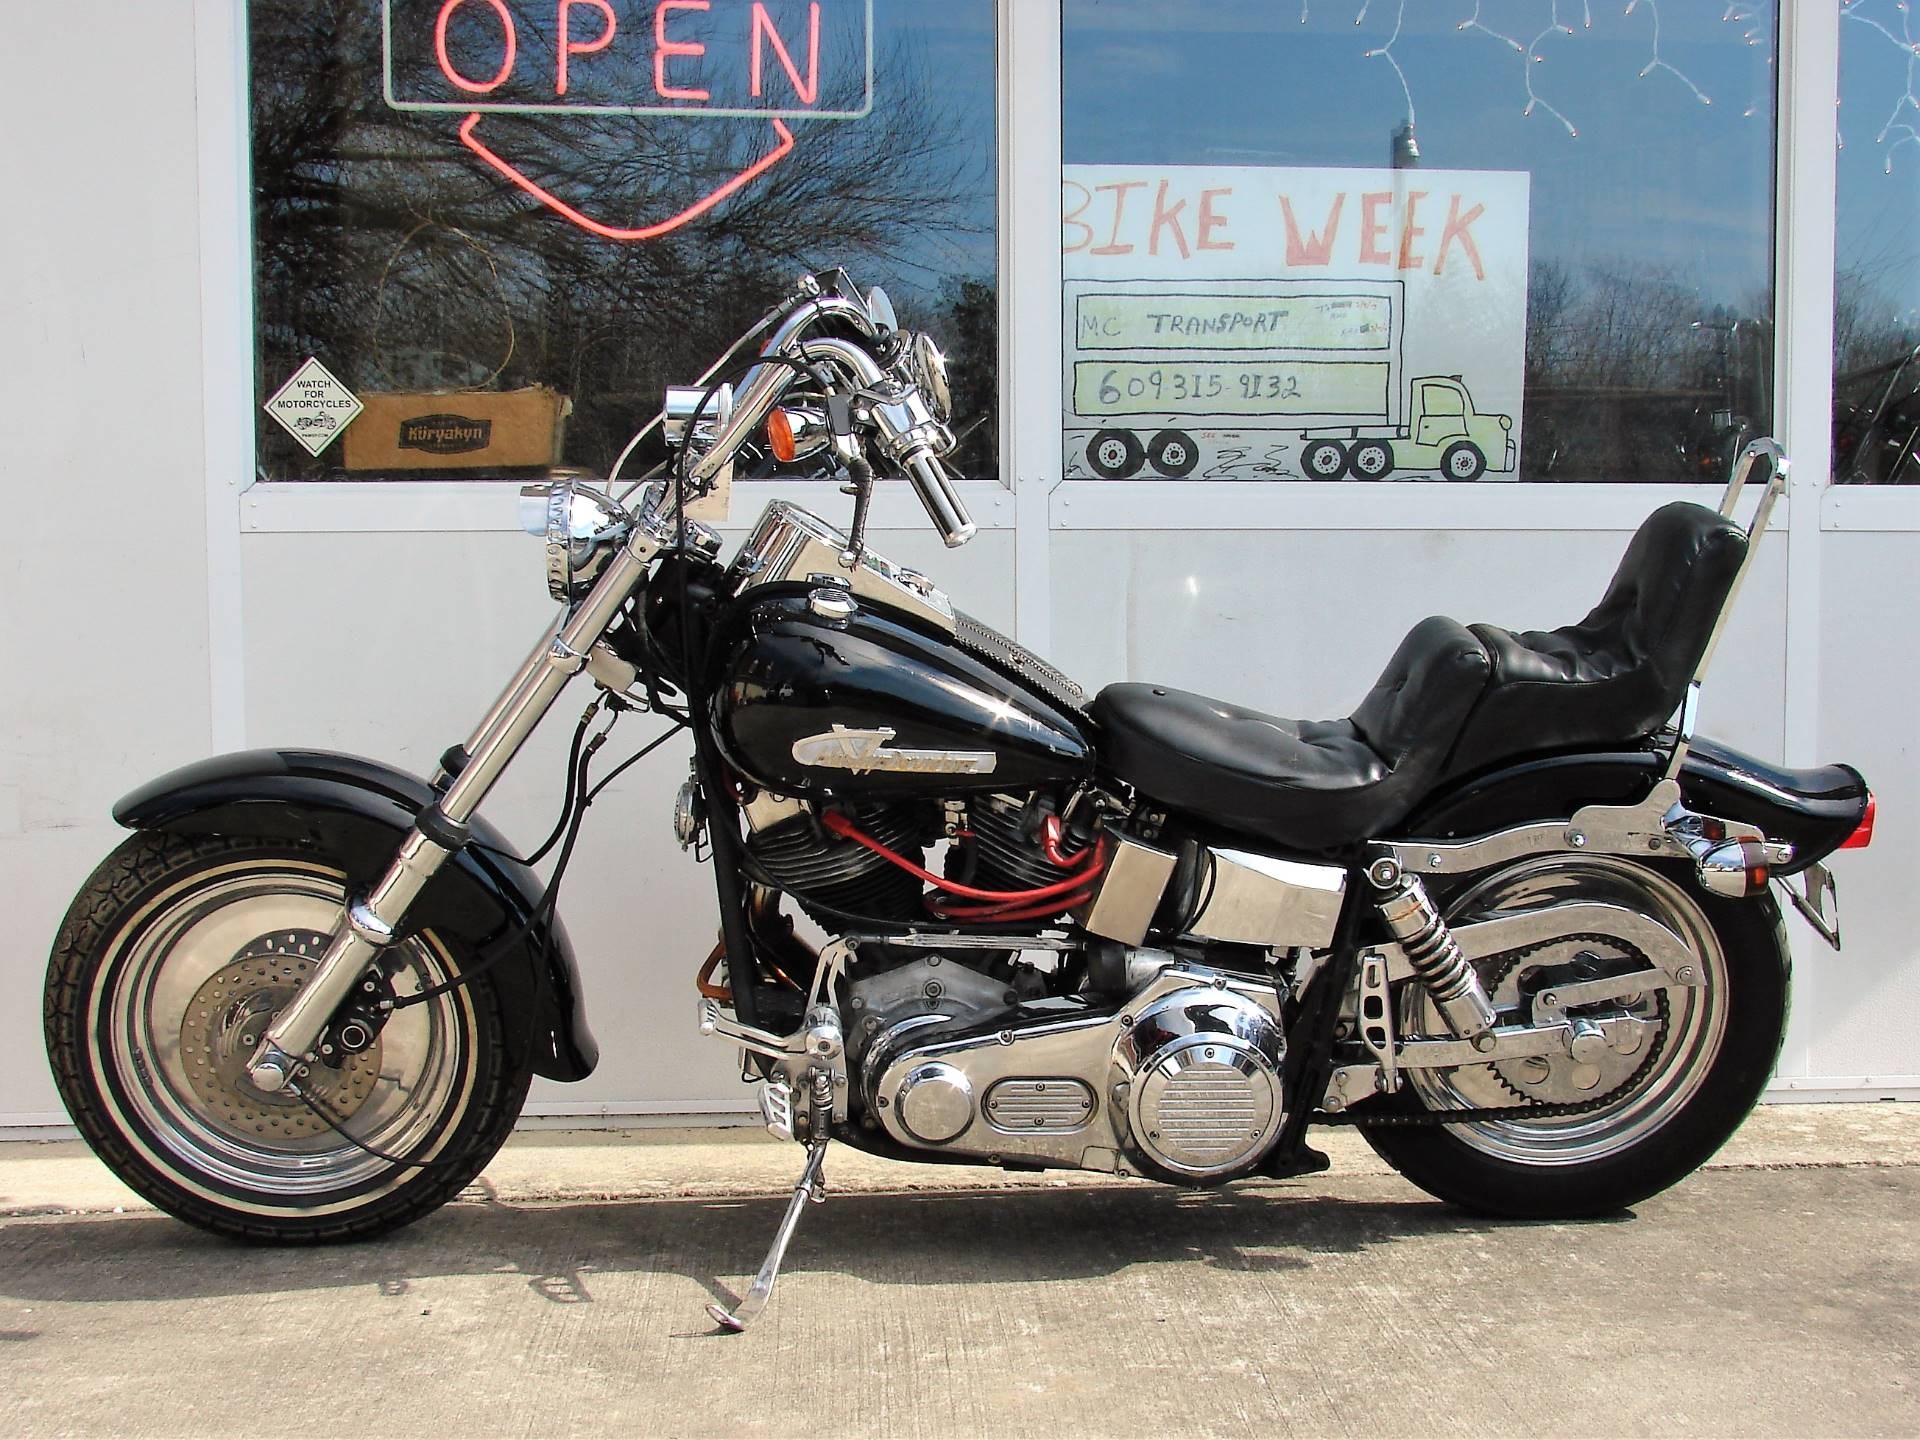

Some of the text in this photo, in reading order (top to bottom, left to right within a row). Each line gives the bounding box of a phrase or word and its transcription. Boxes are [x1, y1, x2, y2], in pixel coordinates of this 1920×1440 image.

[436, 0, 820, 103] OPEN
[1062, 179, 1486, 281] BIKE WEEK
[1147, 310, 1289, 336] TRANSPORT
[297, 380, 331, 389] WATCH
[304, 390, 324, 399] FOR
[277, 400, 351, 409] MOTORCYCLES
[408, 425, 483, 443] Küryakyn
